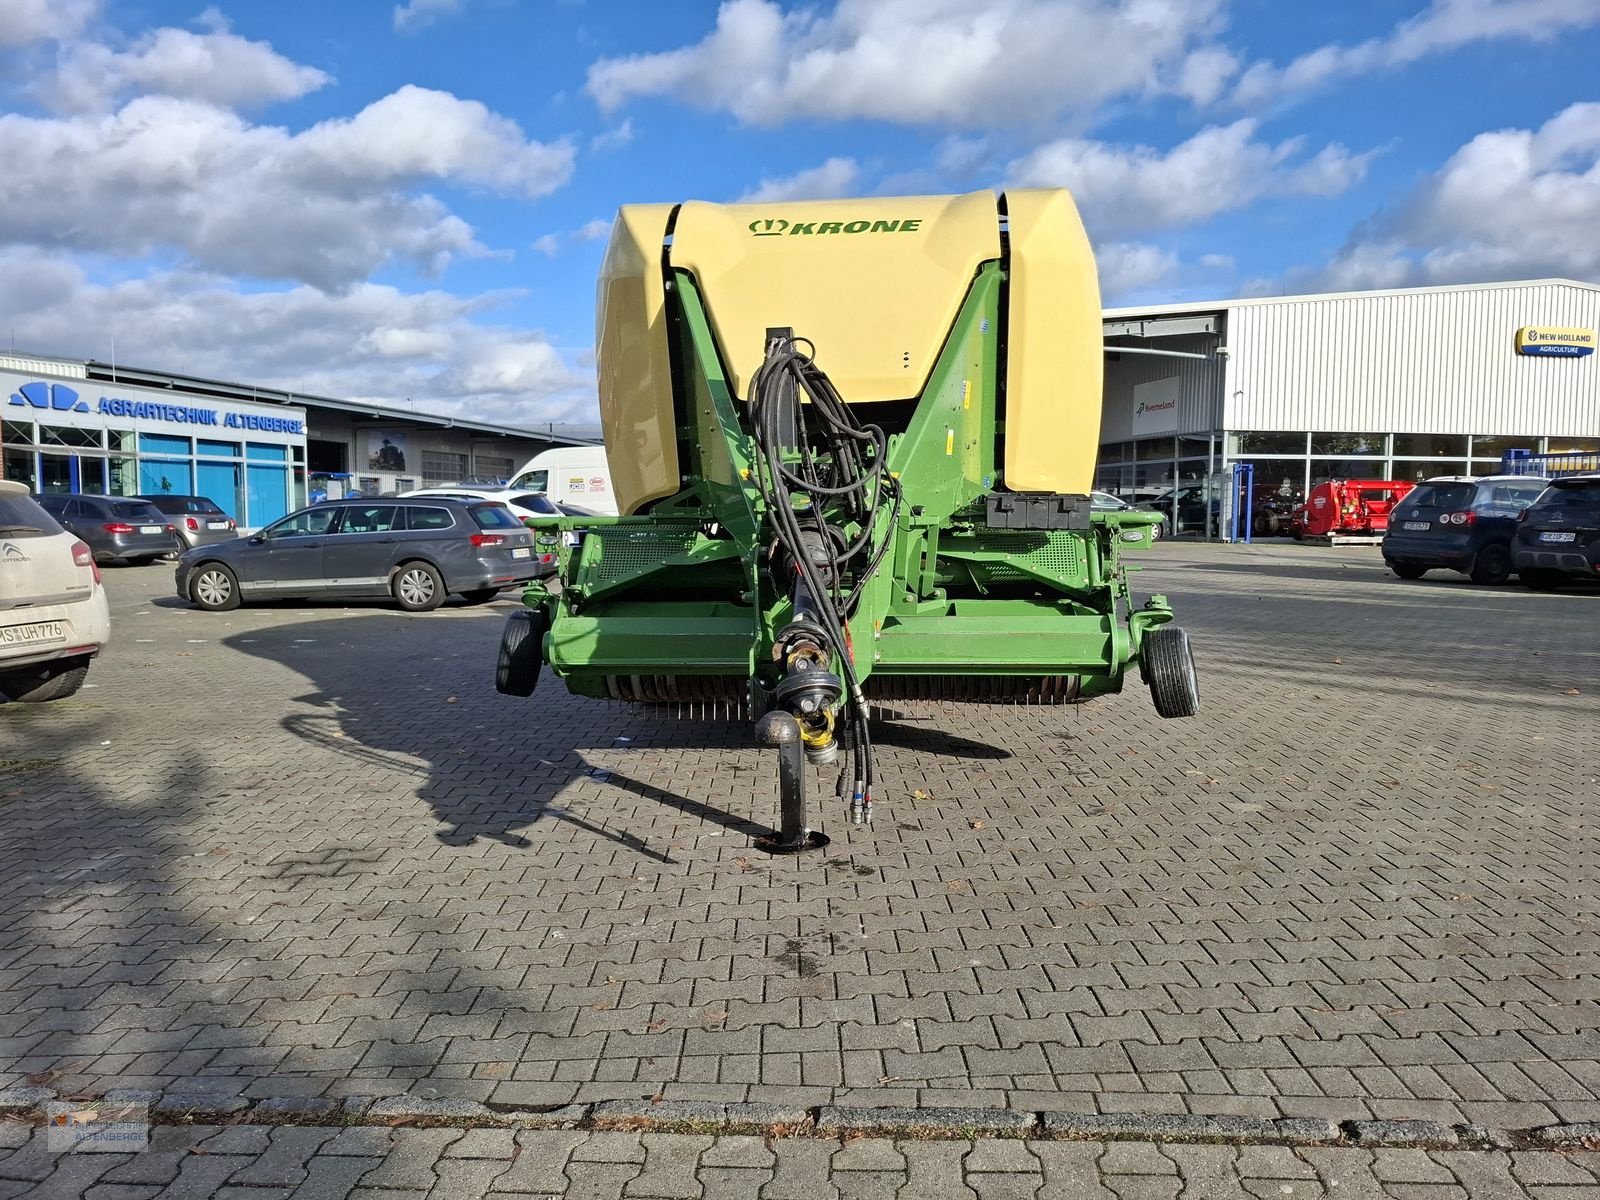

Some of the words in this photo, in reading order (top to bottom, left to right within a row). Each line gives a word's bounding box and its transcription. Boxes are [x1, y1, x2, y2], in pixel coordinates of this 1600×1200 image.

[788, 219, 923, 236] KRONE
[1539, 333, 1557, 341] NEW
[1557, 334, 1591, 342] HOLLAND
[97, 397, 219, 426] AGRARTECHNIK
[224, 412, 306, 435] ALTENBERGE
